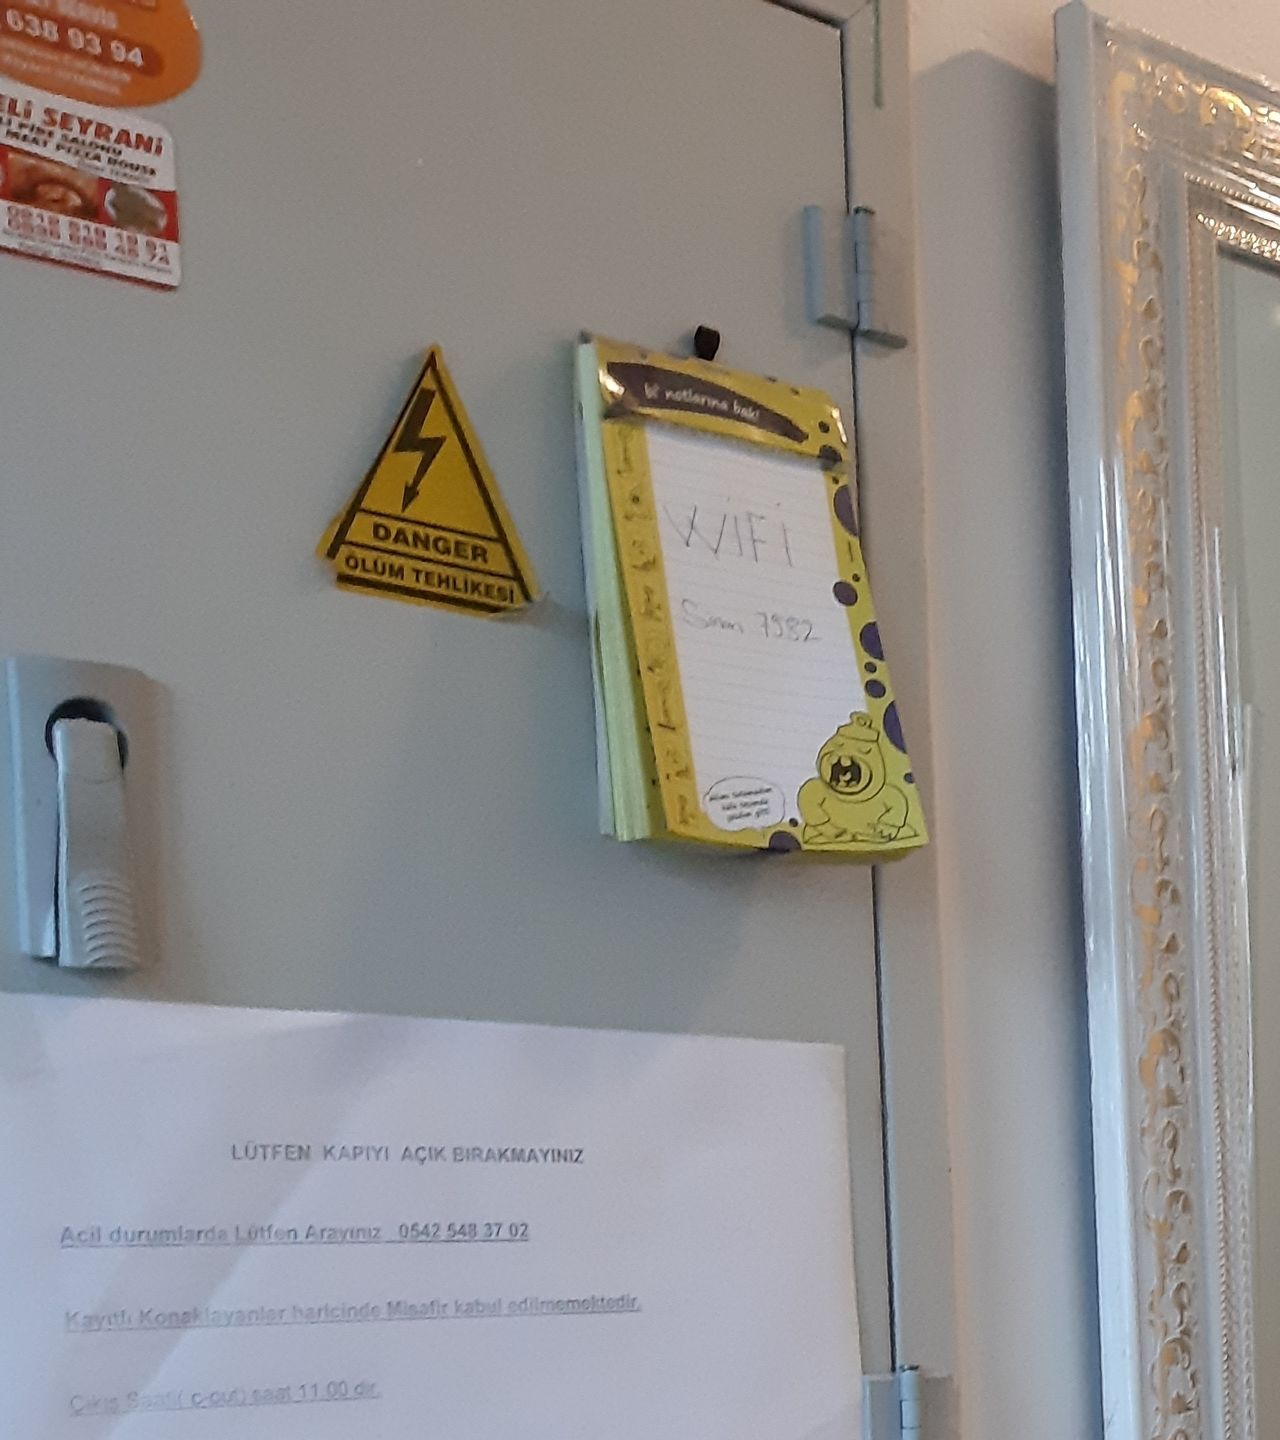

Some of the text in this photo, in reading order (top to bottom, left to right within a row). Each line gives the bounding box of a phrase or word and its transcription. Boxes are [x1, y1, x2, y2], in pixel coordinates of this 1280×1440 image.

[372, 520, 489, 565] DANGER
[411, 567, 515, 605] TEHLİKESİ
[231, 1141, 585, 1166] LÜTFEN KAPIYI AÇIK BIRAKMAYINIZ
[60, 1225, 101, 1244] Acil
[109, 1224, 228, 1243] durumlarda
[234, 1223, 299, 1242] Lütfen
[305, 1224, 381, 1243] Arayınız
[508, 1222, 529, 1238] 02
[139, 1303, 286, 1328] Konaklayanlar
[454, 1297, 502, 1314] kabul
